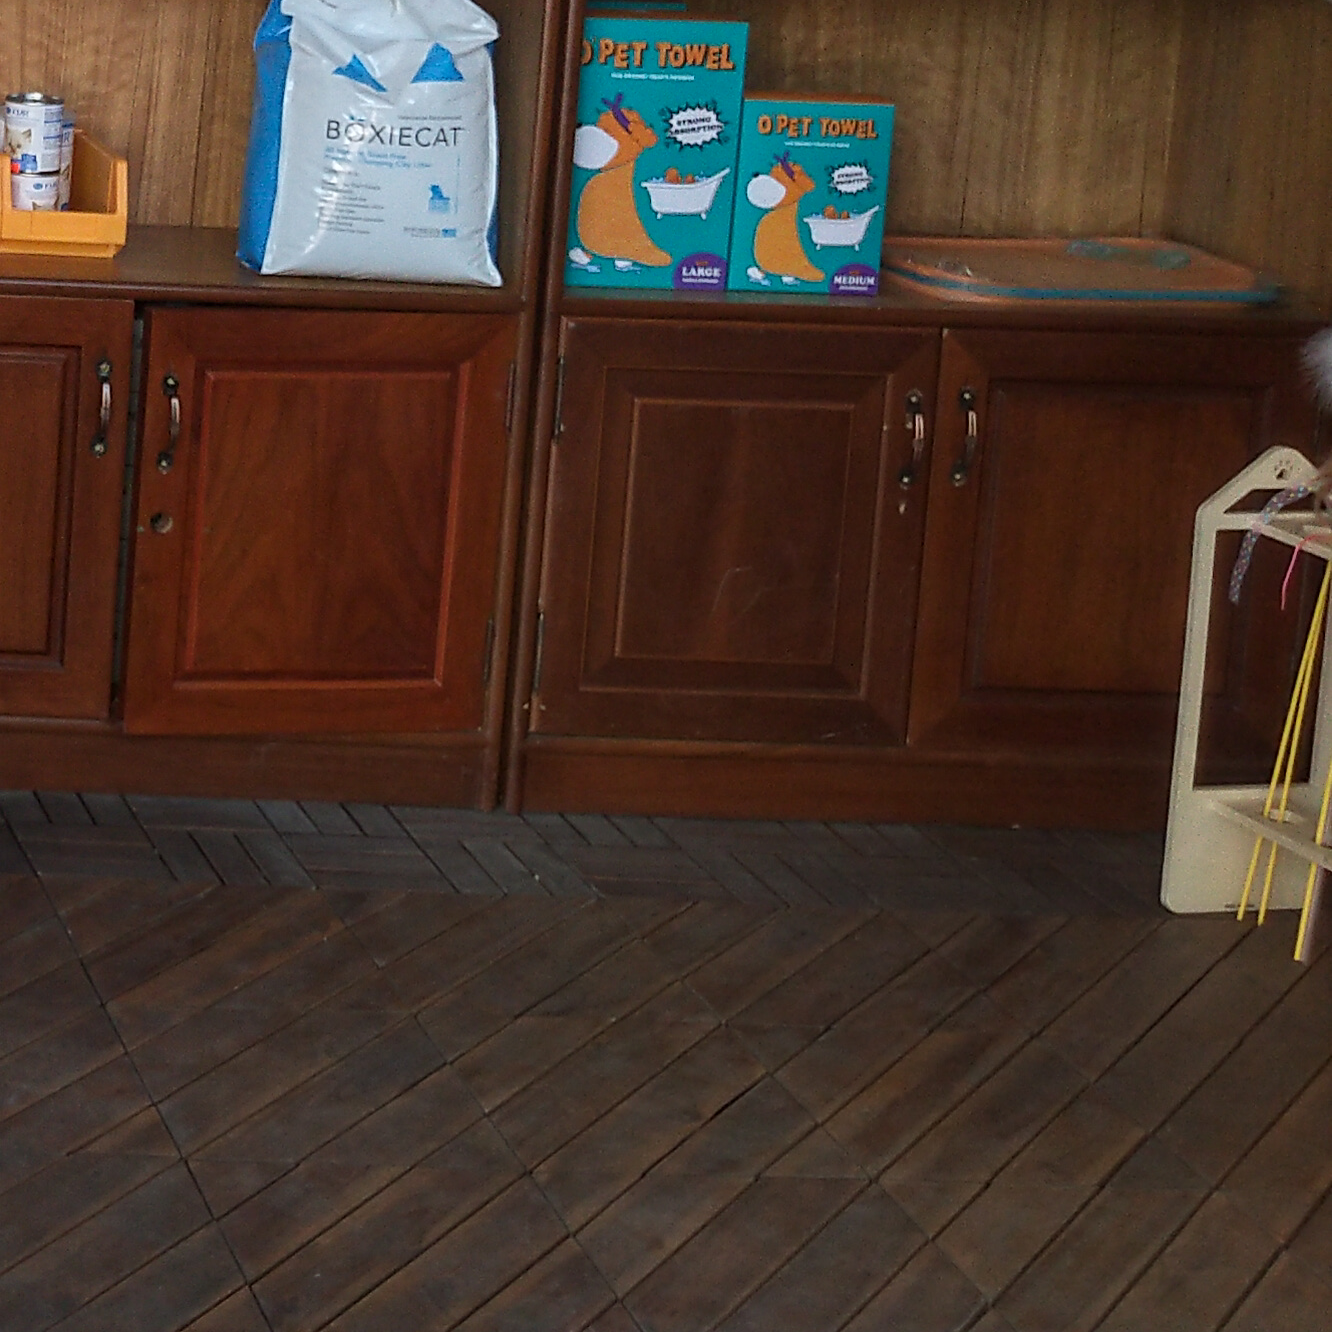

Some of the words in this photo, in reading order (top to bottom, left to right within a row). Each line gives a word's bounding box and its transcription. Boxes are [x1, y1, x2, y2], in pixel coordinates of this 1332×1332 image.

[654, 41, 736, 70] TOWEL
[676, 116, 712, 127] STRONG
[818, 117, 878, 139] TOWEL
[326, 120, 465, 148] BOXIECAT
[681, 266, 721, 278] LARGE
[833, 275, 875, 286] MEDIUM
